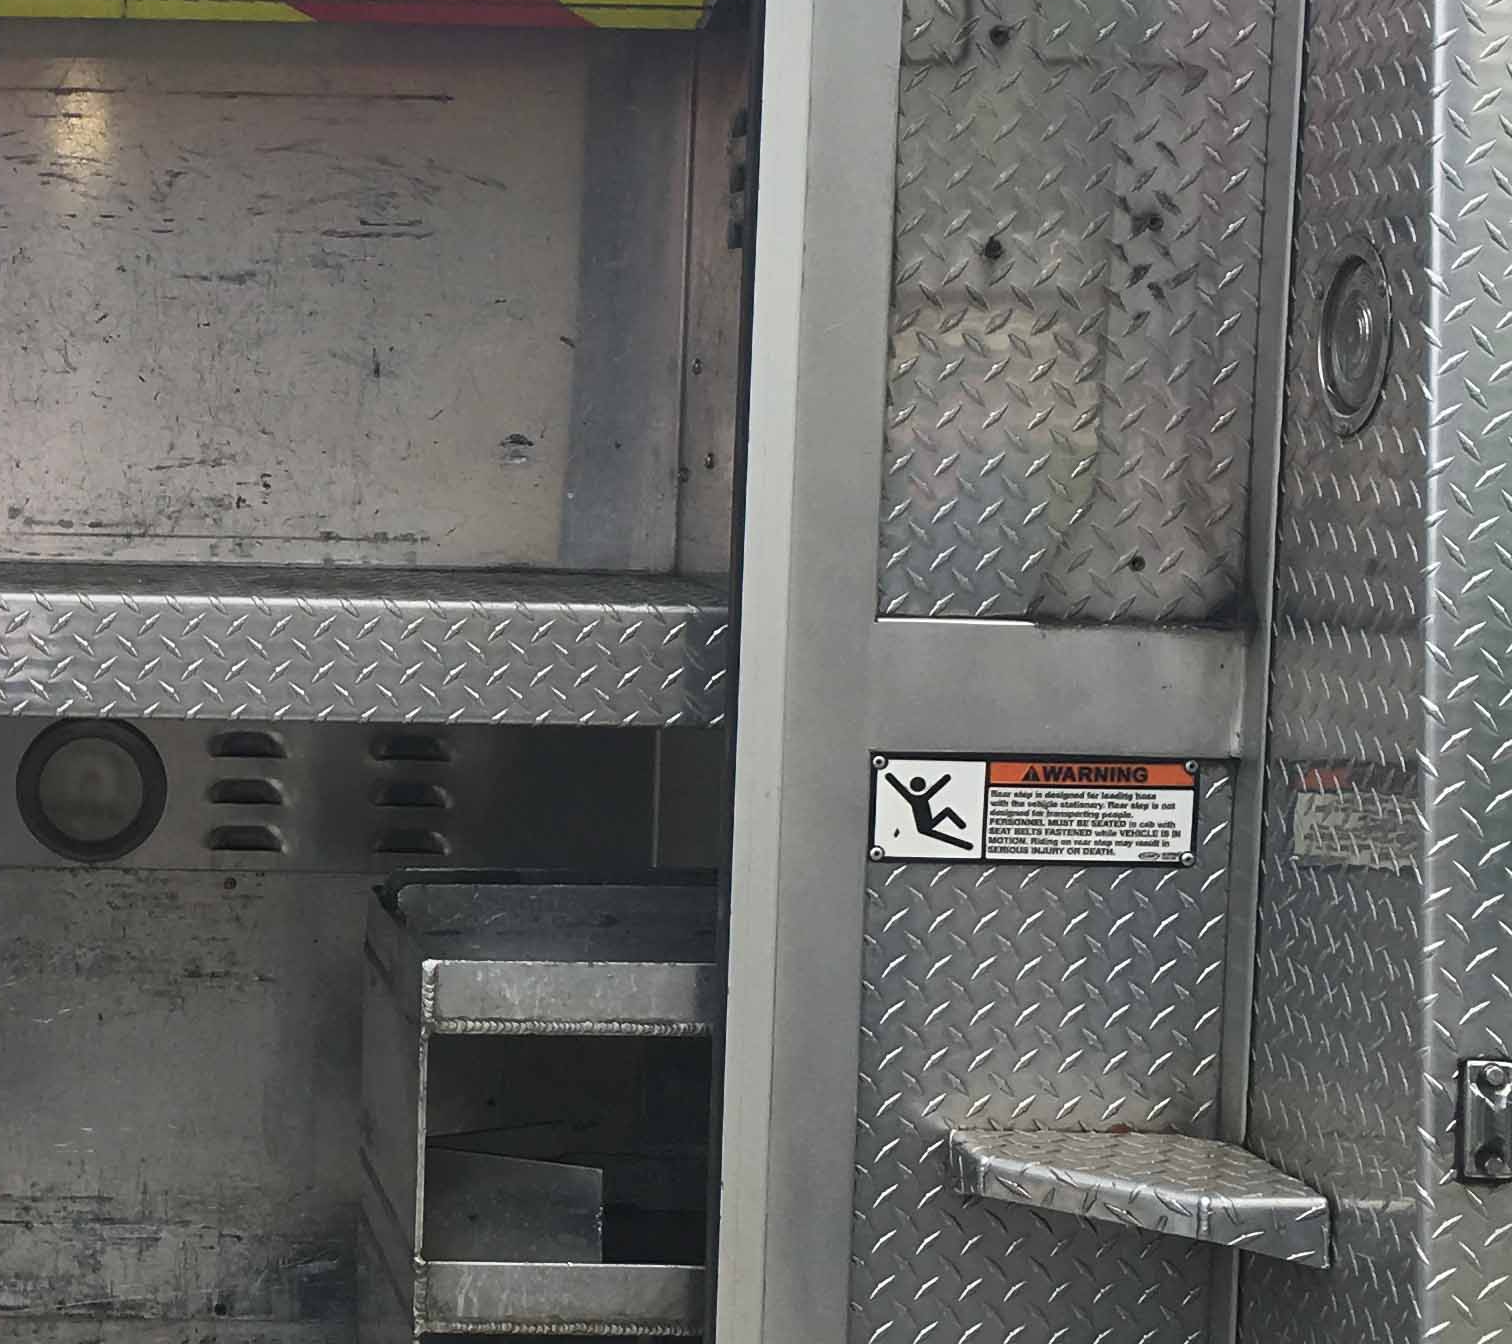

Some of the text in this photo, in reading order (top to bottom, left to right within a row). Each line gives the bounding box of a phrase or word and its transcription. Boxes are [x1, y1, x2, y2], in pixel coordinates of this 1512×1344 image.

[1042, 766, 1148, 782] WARNING
[1014, 791, 1032, 799] step
[1102, 792, 1132, 800] loading
[1060, 801, 1105, 809] stationary.
[1131, 803, 1148, 811] step
[1047, 810, 1099, 818] transporting
[988, 846, 1028, 854] SERIOUS
[1083, 848, 1115, 856] DEATH.
